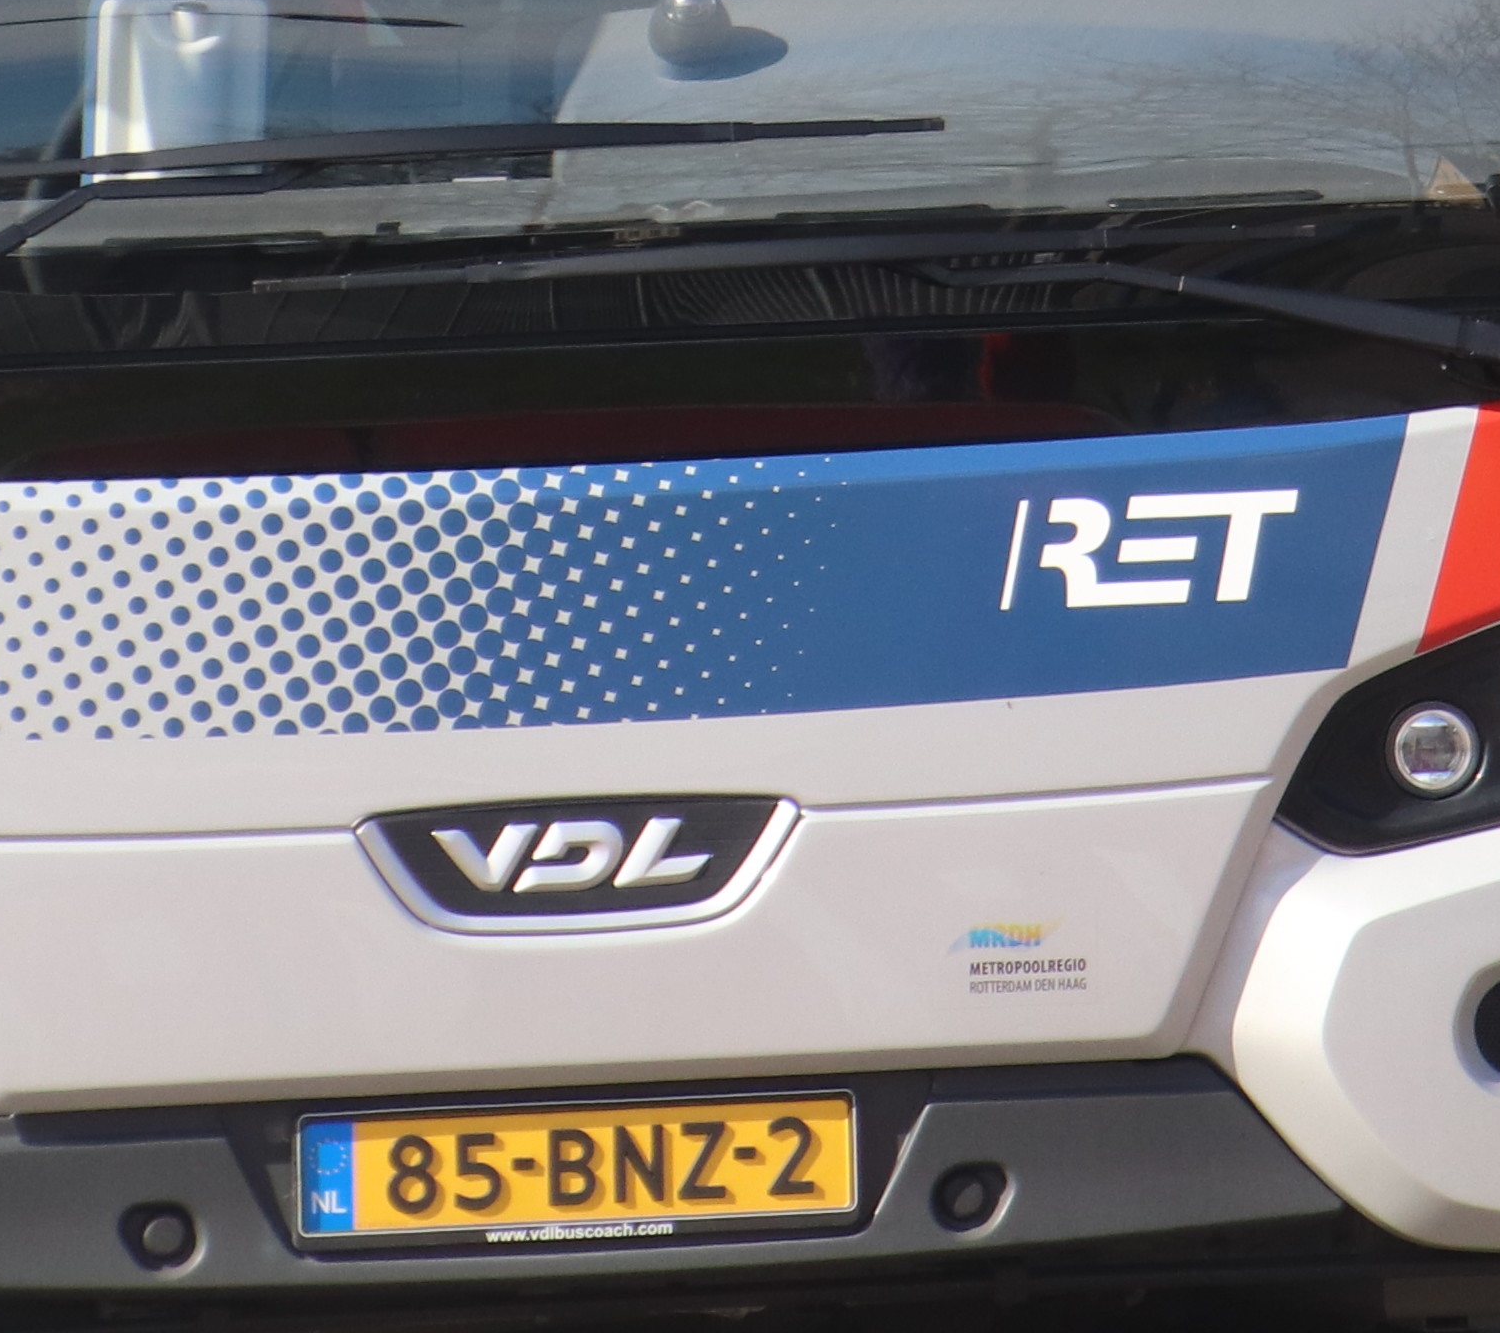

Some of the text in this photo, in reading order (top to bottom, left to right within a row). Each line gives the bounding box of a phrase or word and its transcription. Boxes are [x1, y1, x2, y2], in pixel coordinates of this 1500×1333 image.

[1000, 490, 1298, 610] RET
[430, 816, 714, 893] VDL
[968, 923, 1043, 948] MRDH
[969, 957, 1087, 975] METROPOOLREGIO
[969, 977, 1087, 994] ROTTERDAM DEN HAAG
[386, 1116, 817, 1215] 85-BNZ-2
[311, 1189, 348, 1216] NL
[485, 1221, 674, 1244] www.vdlbuscoach.com
